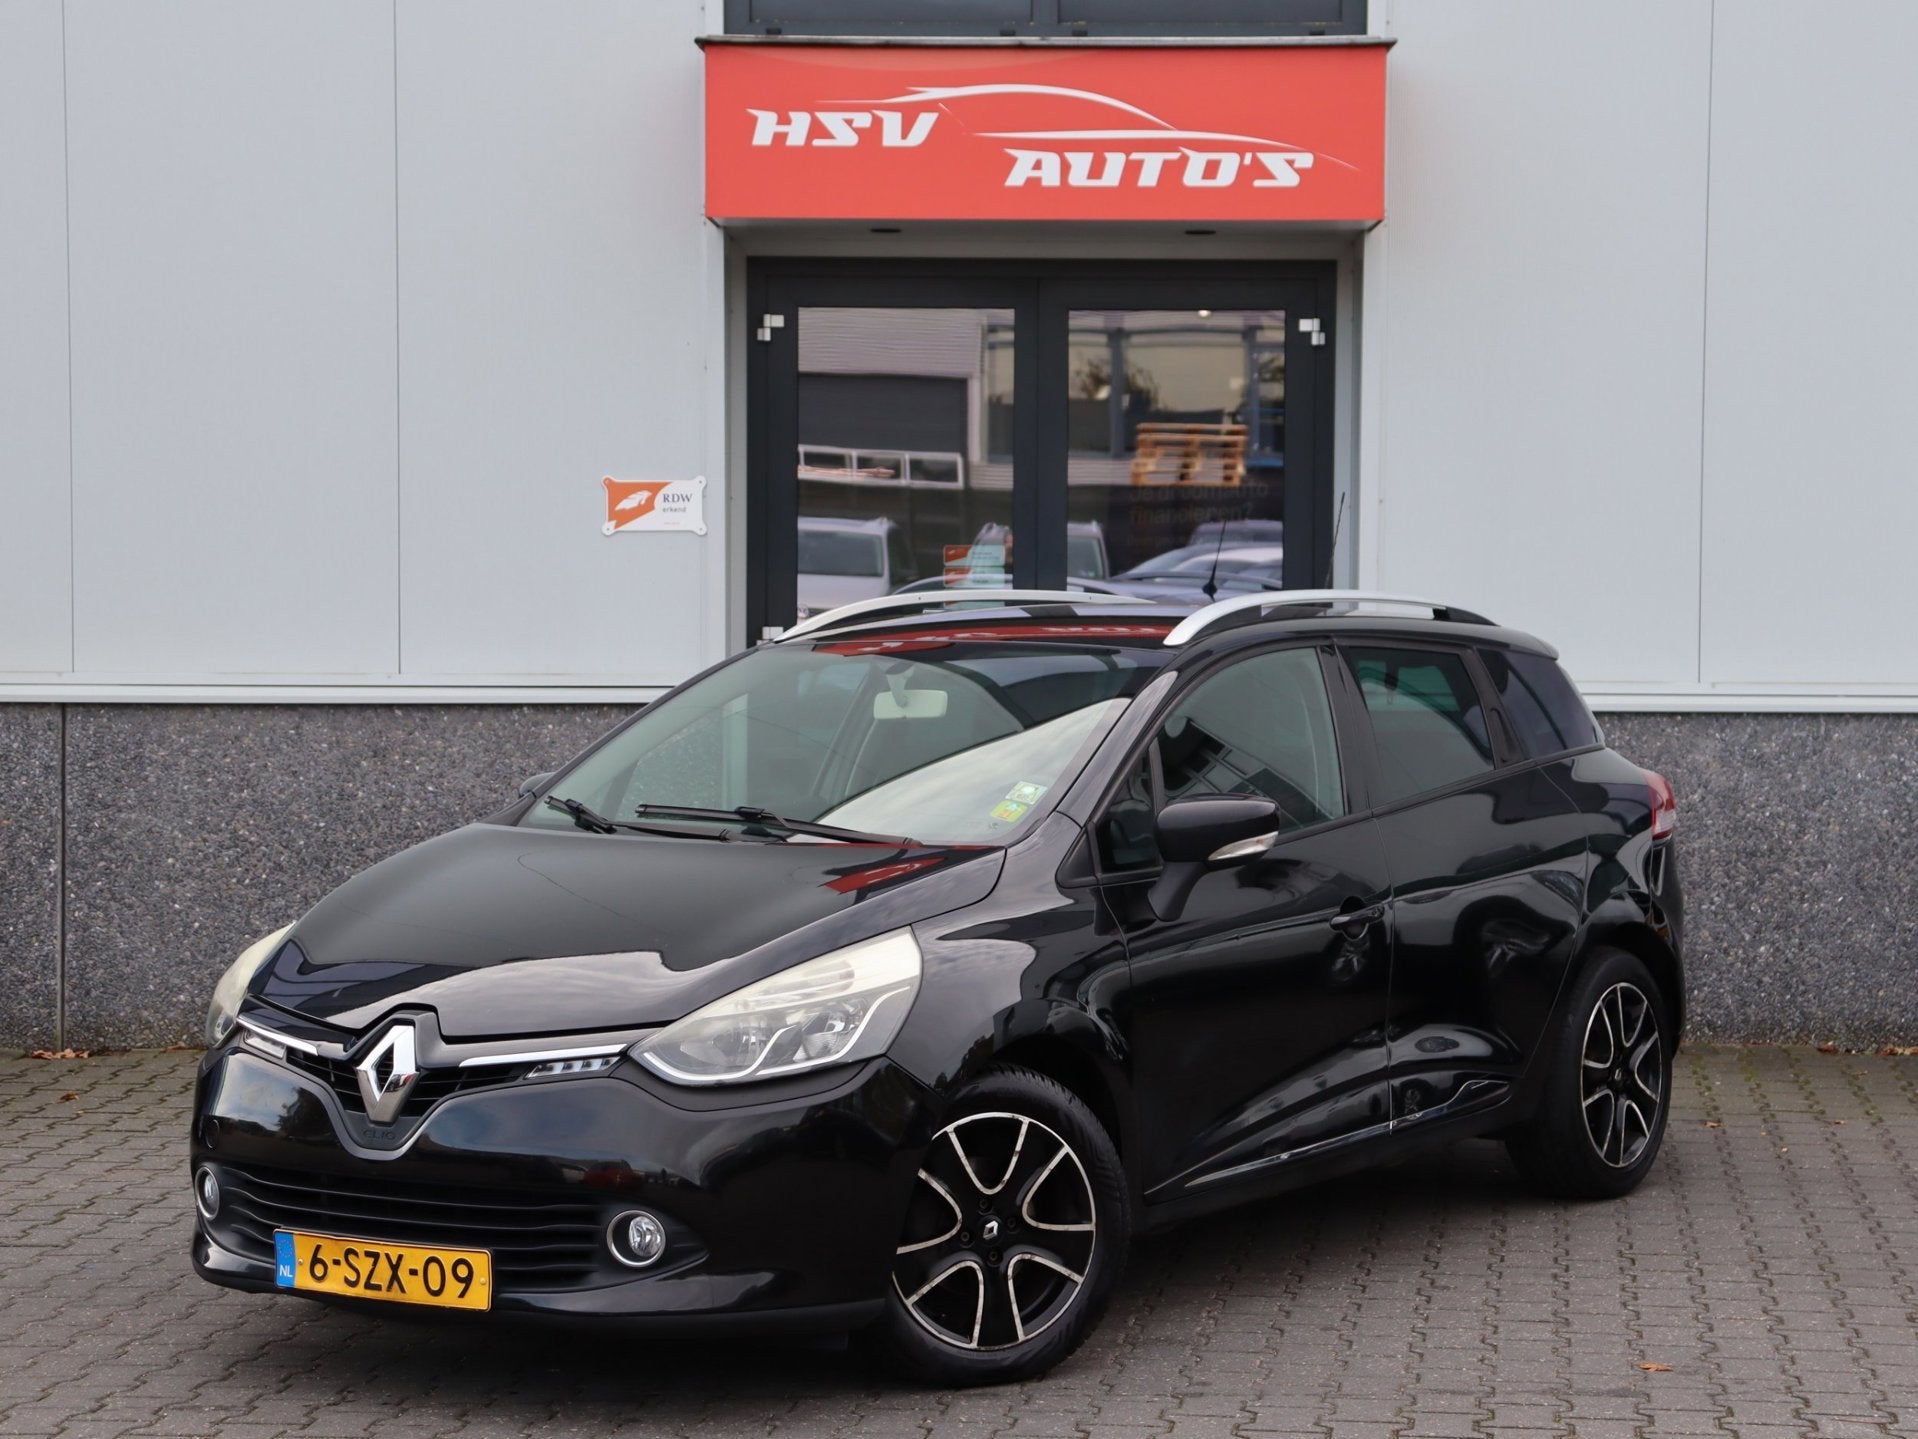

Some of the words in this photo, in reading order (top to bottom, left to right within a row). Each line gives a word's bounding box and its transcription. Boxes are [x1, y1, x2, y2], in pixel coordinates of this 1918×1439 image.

[746, 108, 940, 147] HSV
[1003, 146, 1315, 188] AUTO'S
[662, 493, 694, 503] RDW
[363, 1128, 397, 1141] CLIO
[279, 1264, 293, 1279] NL
[309, 1244, 475, 1299] 6-SZX-09
